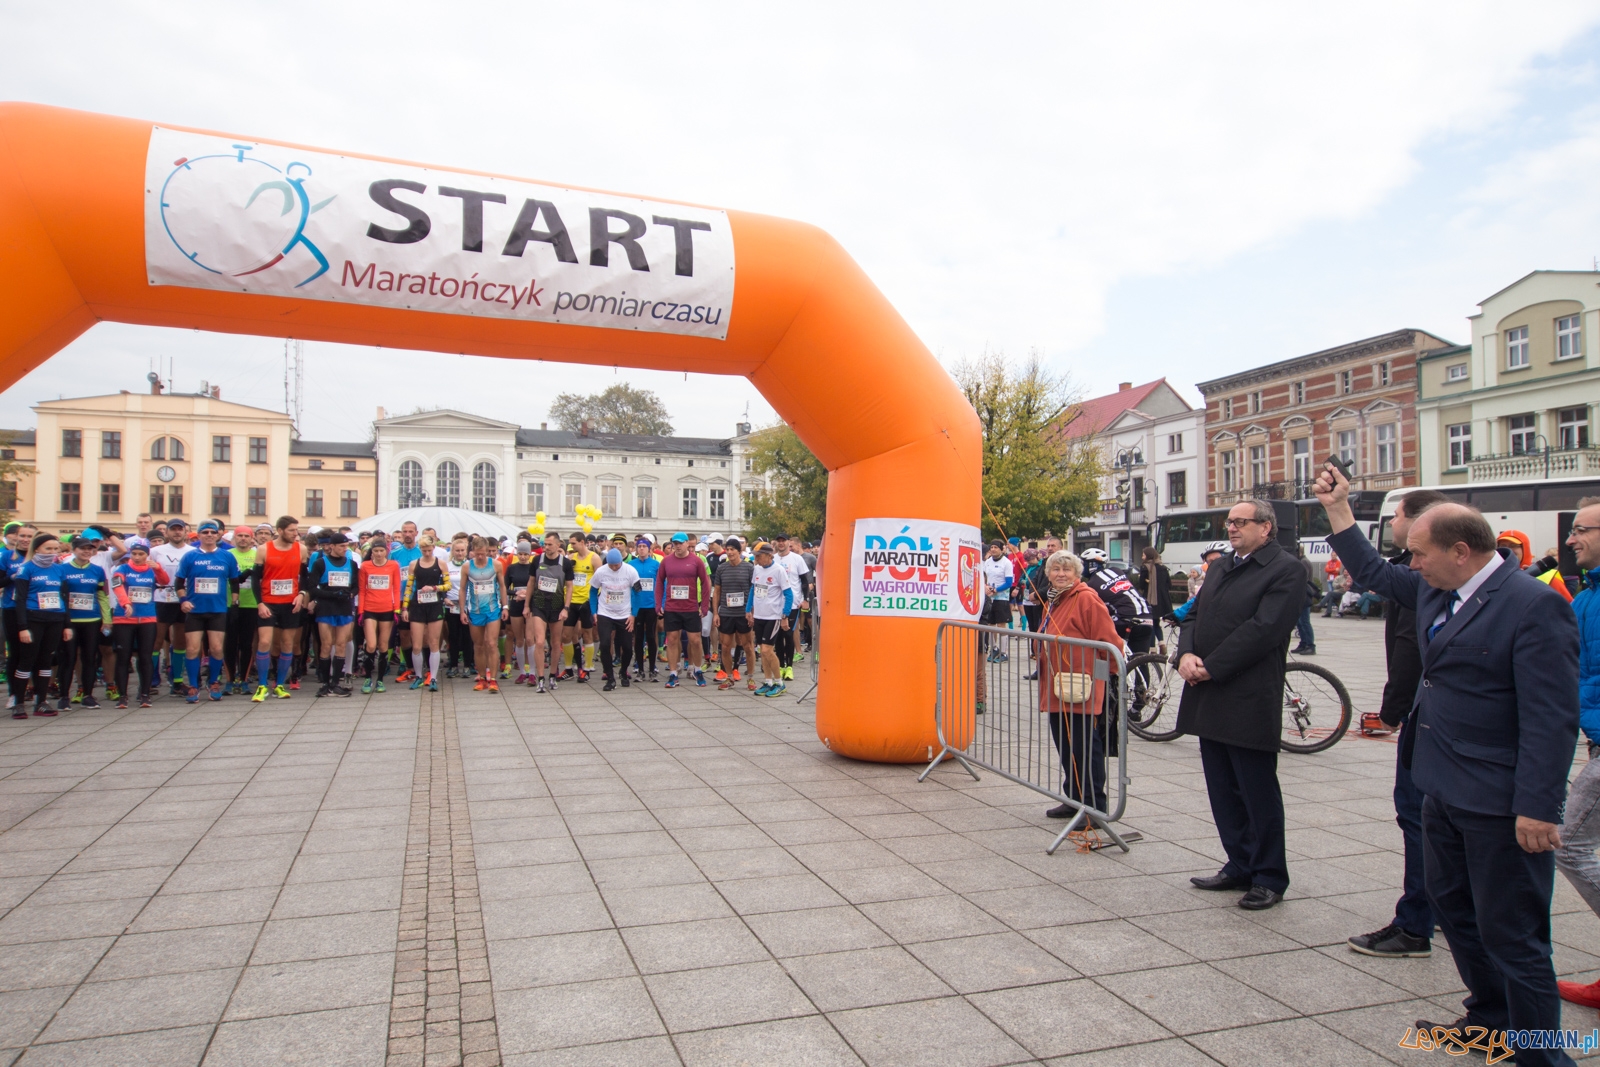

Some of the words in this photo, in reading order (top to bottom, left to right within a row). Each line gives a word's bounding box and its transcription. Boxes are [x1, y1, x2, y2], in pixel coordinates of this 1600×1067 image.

[366, 177, 711, 278] START
[341, 258, 545, 310] Maratończyk
[864, 551, 938, 567] MARATON
[939, 537, 951, 582] SKOKI
[862, 580, 948, 596] WĄGROWIEC
[45, 596, 58, 604] 132
[74, 597, 89, 605] 249
[863, 596, 948, 612] 23.10.2016
